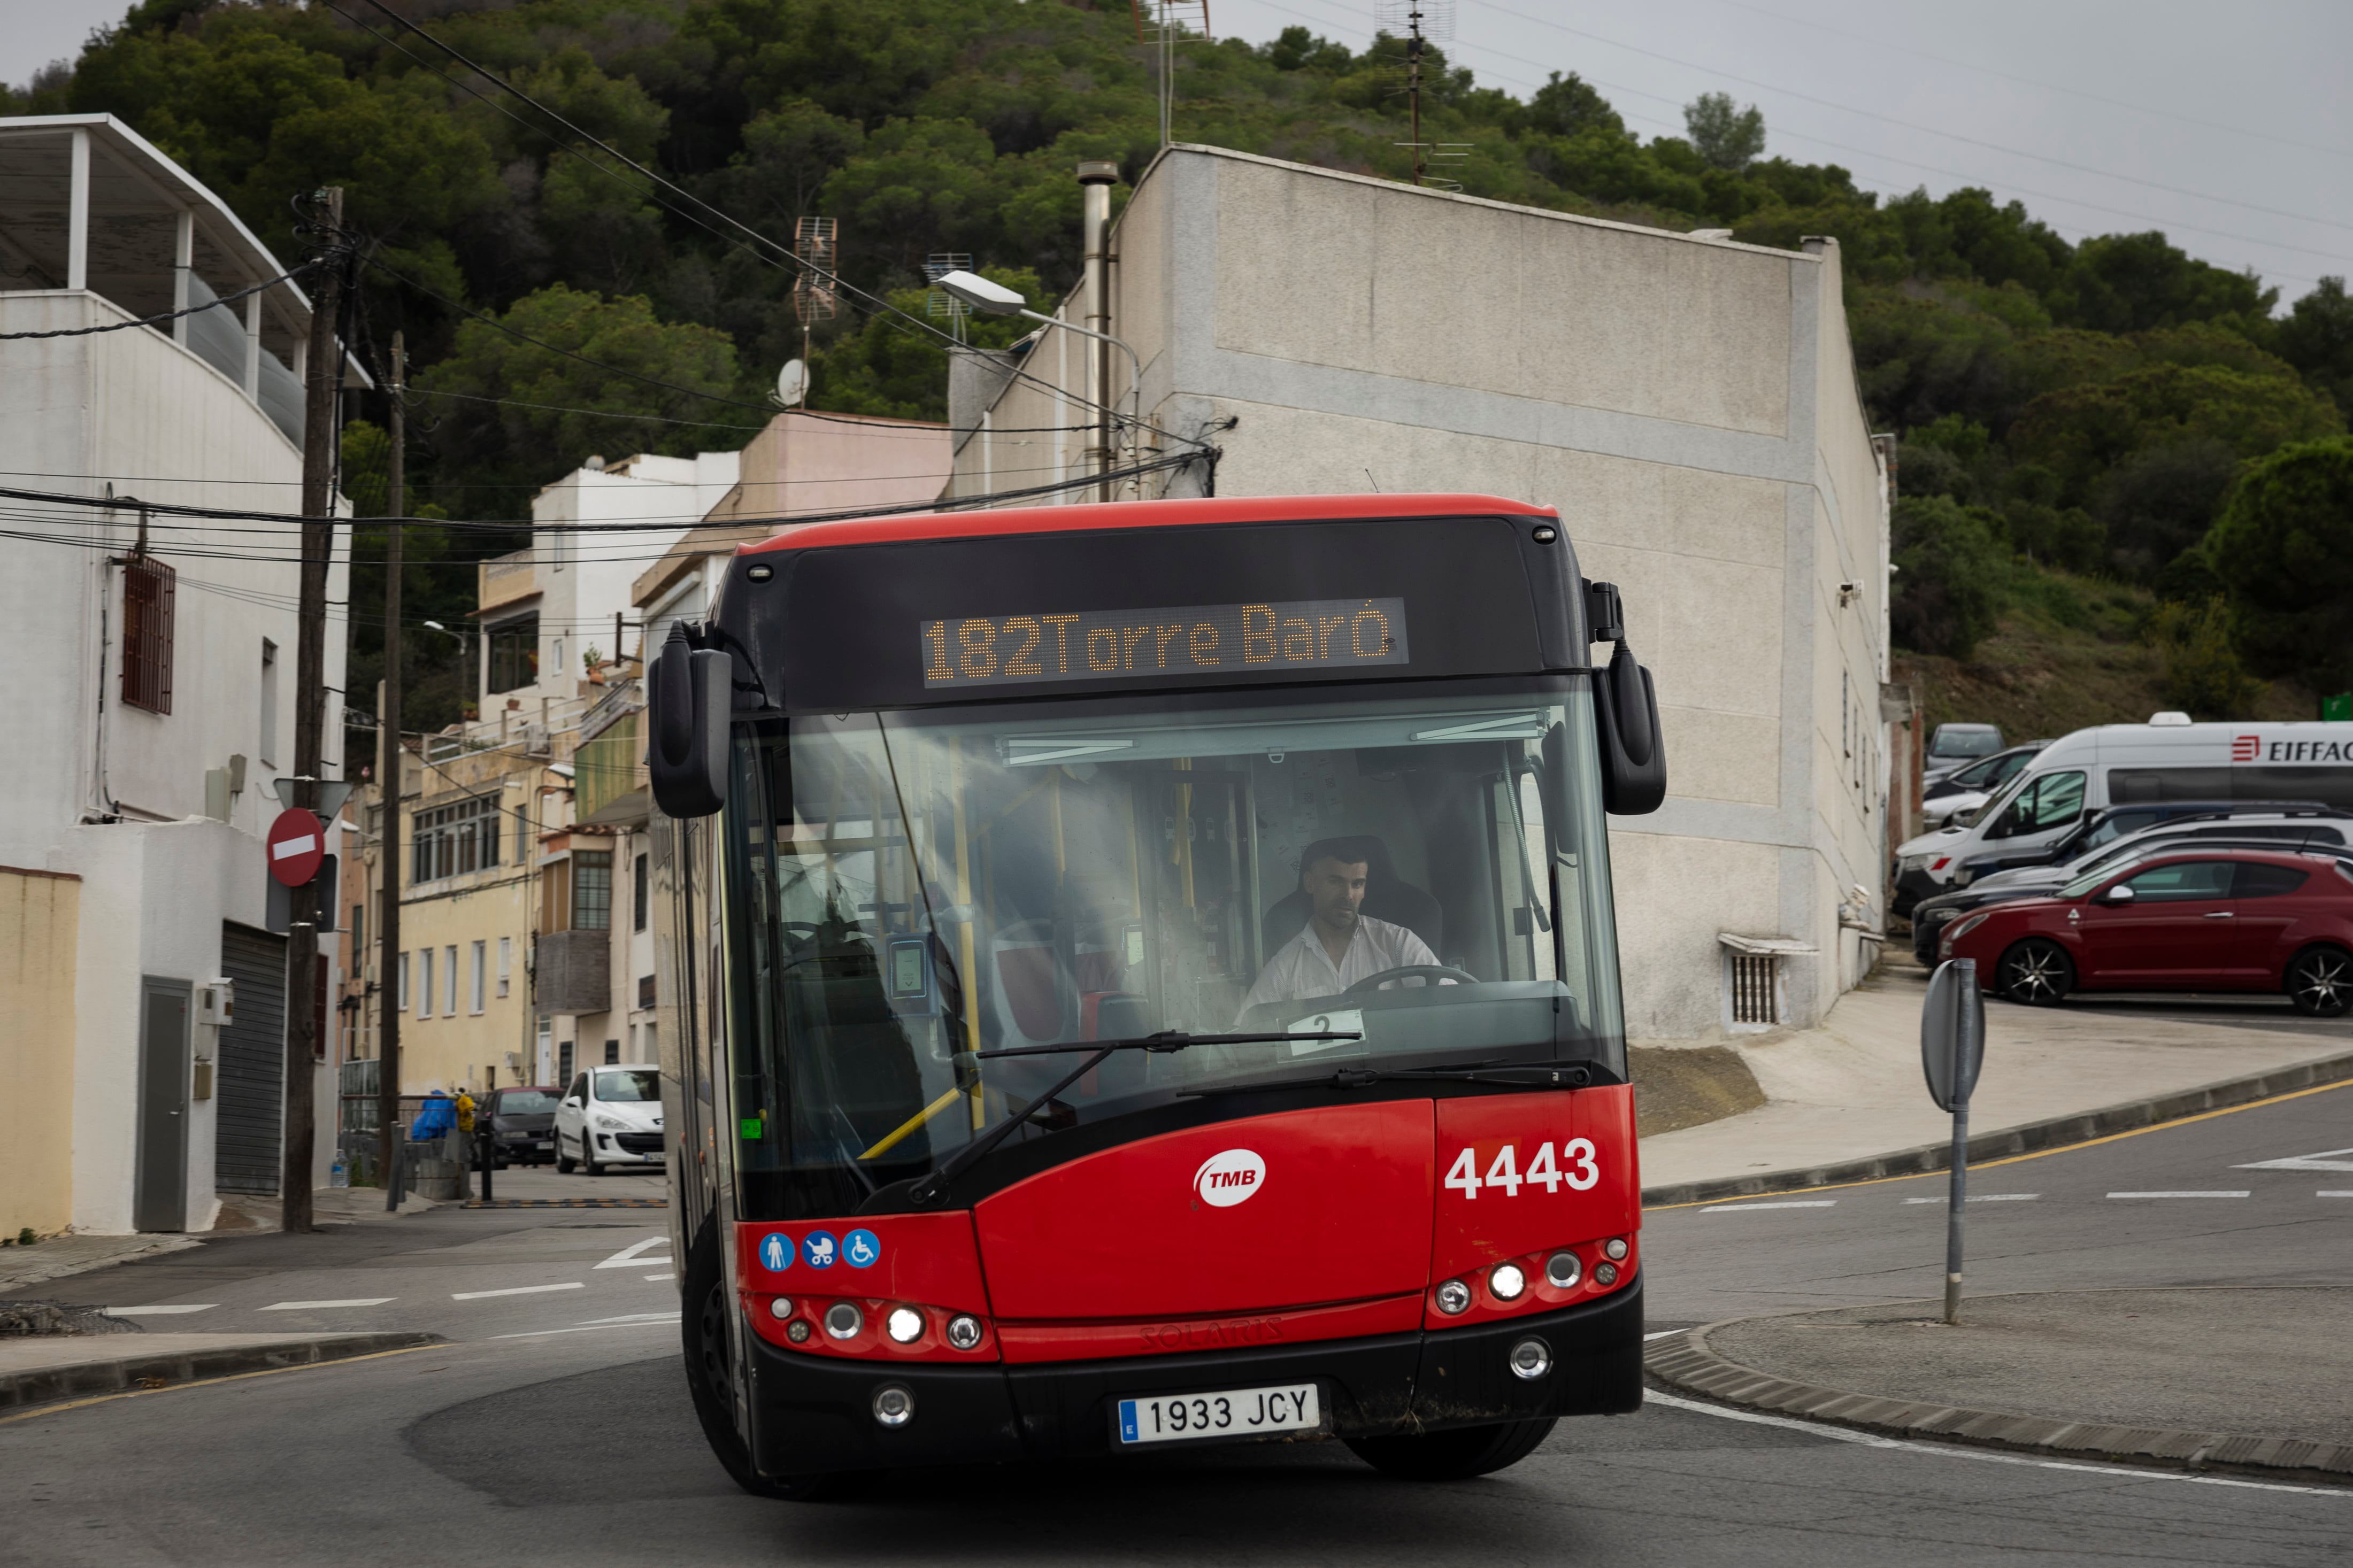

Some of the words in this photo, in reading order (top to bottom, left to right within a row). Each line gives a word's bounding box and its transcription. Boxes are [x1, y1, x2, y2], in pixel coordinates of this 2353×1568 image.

[1242, 599, 1389, 662] Baró
[1313, 1015, 1334, 1046] 2
[1210, 1169, 1256, 1188] TMB
[1444, 1138, 1599, 1199] 4443
[1140, 1316, 1283, 1351] SOLARIS
[1126, 1425, 1134, 1434] E
[1150, 1397, 1232, 1433] 1933
[1248, 1390, 1307, 1425] JCY
